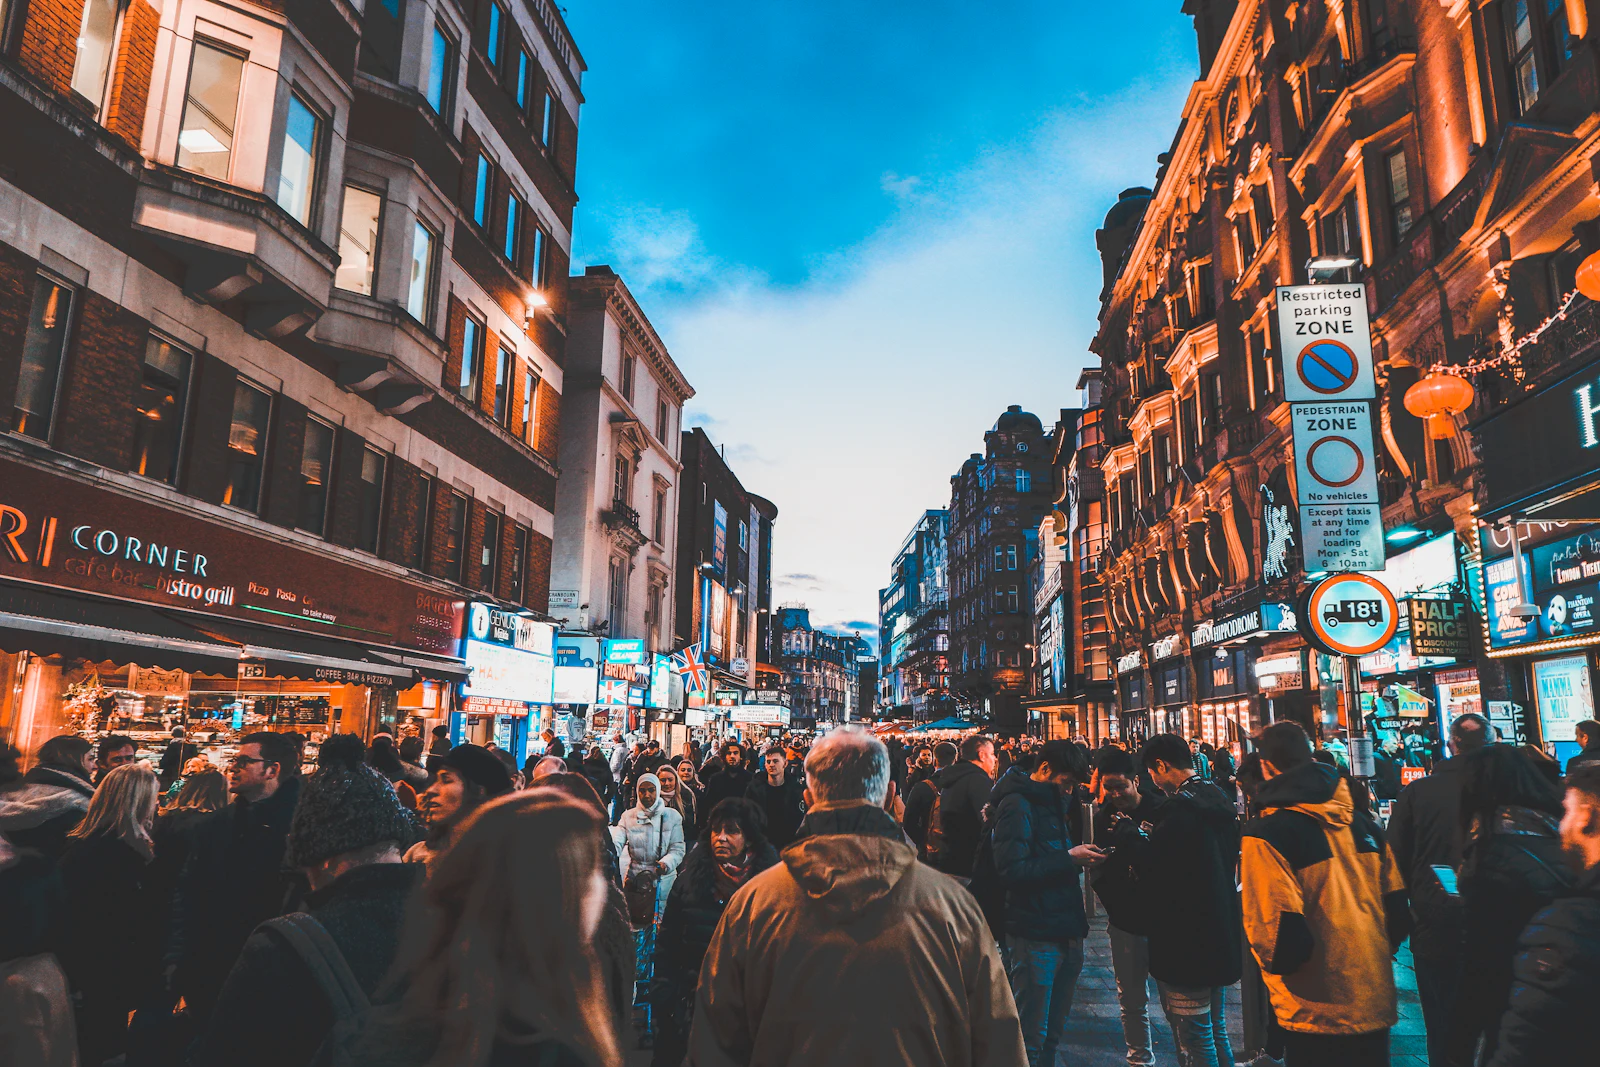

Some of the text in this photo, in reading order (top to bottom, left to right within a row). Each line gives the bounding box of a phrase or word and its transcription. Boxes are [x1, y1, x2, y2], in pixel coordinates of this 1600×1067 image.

[1281, 287, 1361, 302] Restricted
[1294, 304, 1352, 318] parking
[1295, 320, 1354, 335] ZONE
[1296, 405, 1365, 415] PEDESTRIAN
[1307, 418, 1357, 431] ZONE
[1308, 492, 1368, 501] No vehicles
[1308, 507, 1371, 517] Except taxis
[1311, 518, 1322, 527] at
[1347, 518, 1370, 526] time
[1323, 528, 1360, 537] and for
[1323, 539, 1362, 547] loading
[71, 525, 208, 577] CORNER
[1317, 549, 1339, 557] Mon
[1351, 548, 1369, 557] Sat
[1321, 559, 1329, 568] 6
[1339, 559, 1367, 567] 10am
[65, 555, 235, 607] cafe bar bistro grill
[1556, 566, 1581, 584] LONDON
[248, 581, 269, 597] Pizza
[276, 588, 297, 602] Pasta
[1493, 582, 1521, 602] COM
[1568, 596, 1594, 608] PHANTOM
[302, 607, 337, 623] to take away
[1347, 601, 1379, 619] 18t
[1412, 600, 1465, 620] HALF
[1573, 610, 1592, 620] OPERA
[489, 609, 516, 630] GENIUS
[1213, 611, 1260, 643] HIPPODROME
[1497, 615, 1527, 632] AWA
[1414, 620, 1469, 637] PRICE
[1416, 639, 1422, 647] &
[315, 668, 342, 680] COFFEE
[347, 671, 360, 682] BAR
[361, 673, 365, 682] &
[366, 674, 393, 686] PIZZERIA
[604, 664, 636, 681] BRITAIN
[1451, 685, 1478, 695] ATM HERE
[1541, 676, 1573, 698] MAMMA
[1401, 701, 1427, 711] ATM
[1512, 703, 1525, 730] ALL
[1380, 720, 1400, 729] QUEEN
[1403, 770, 1423, 782] £1.99
